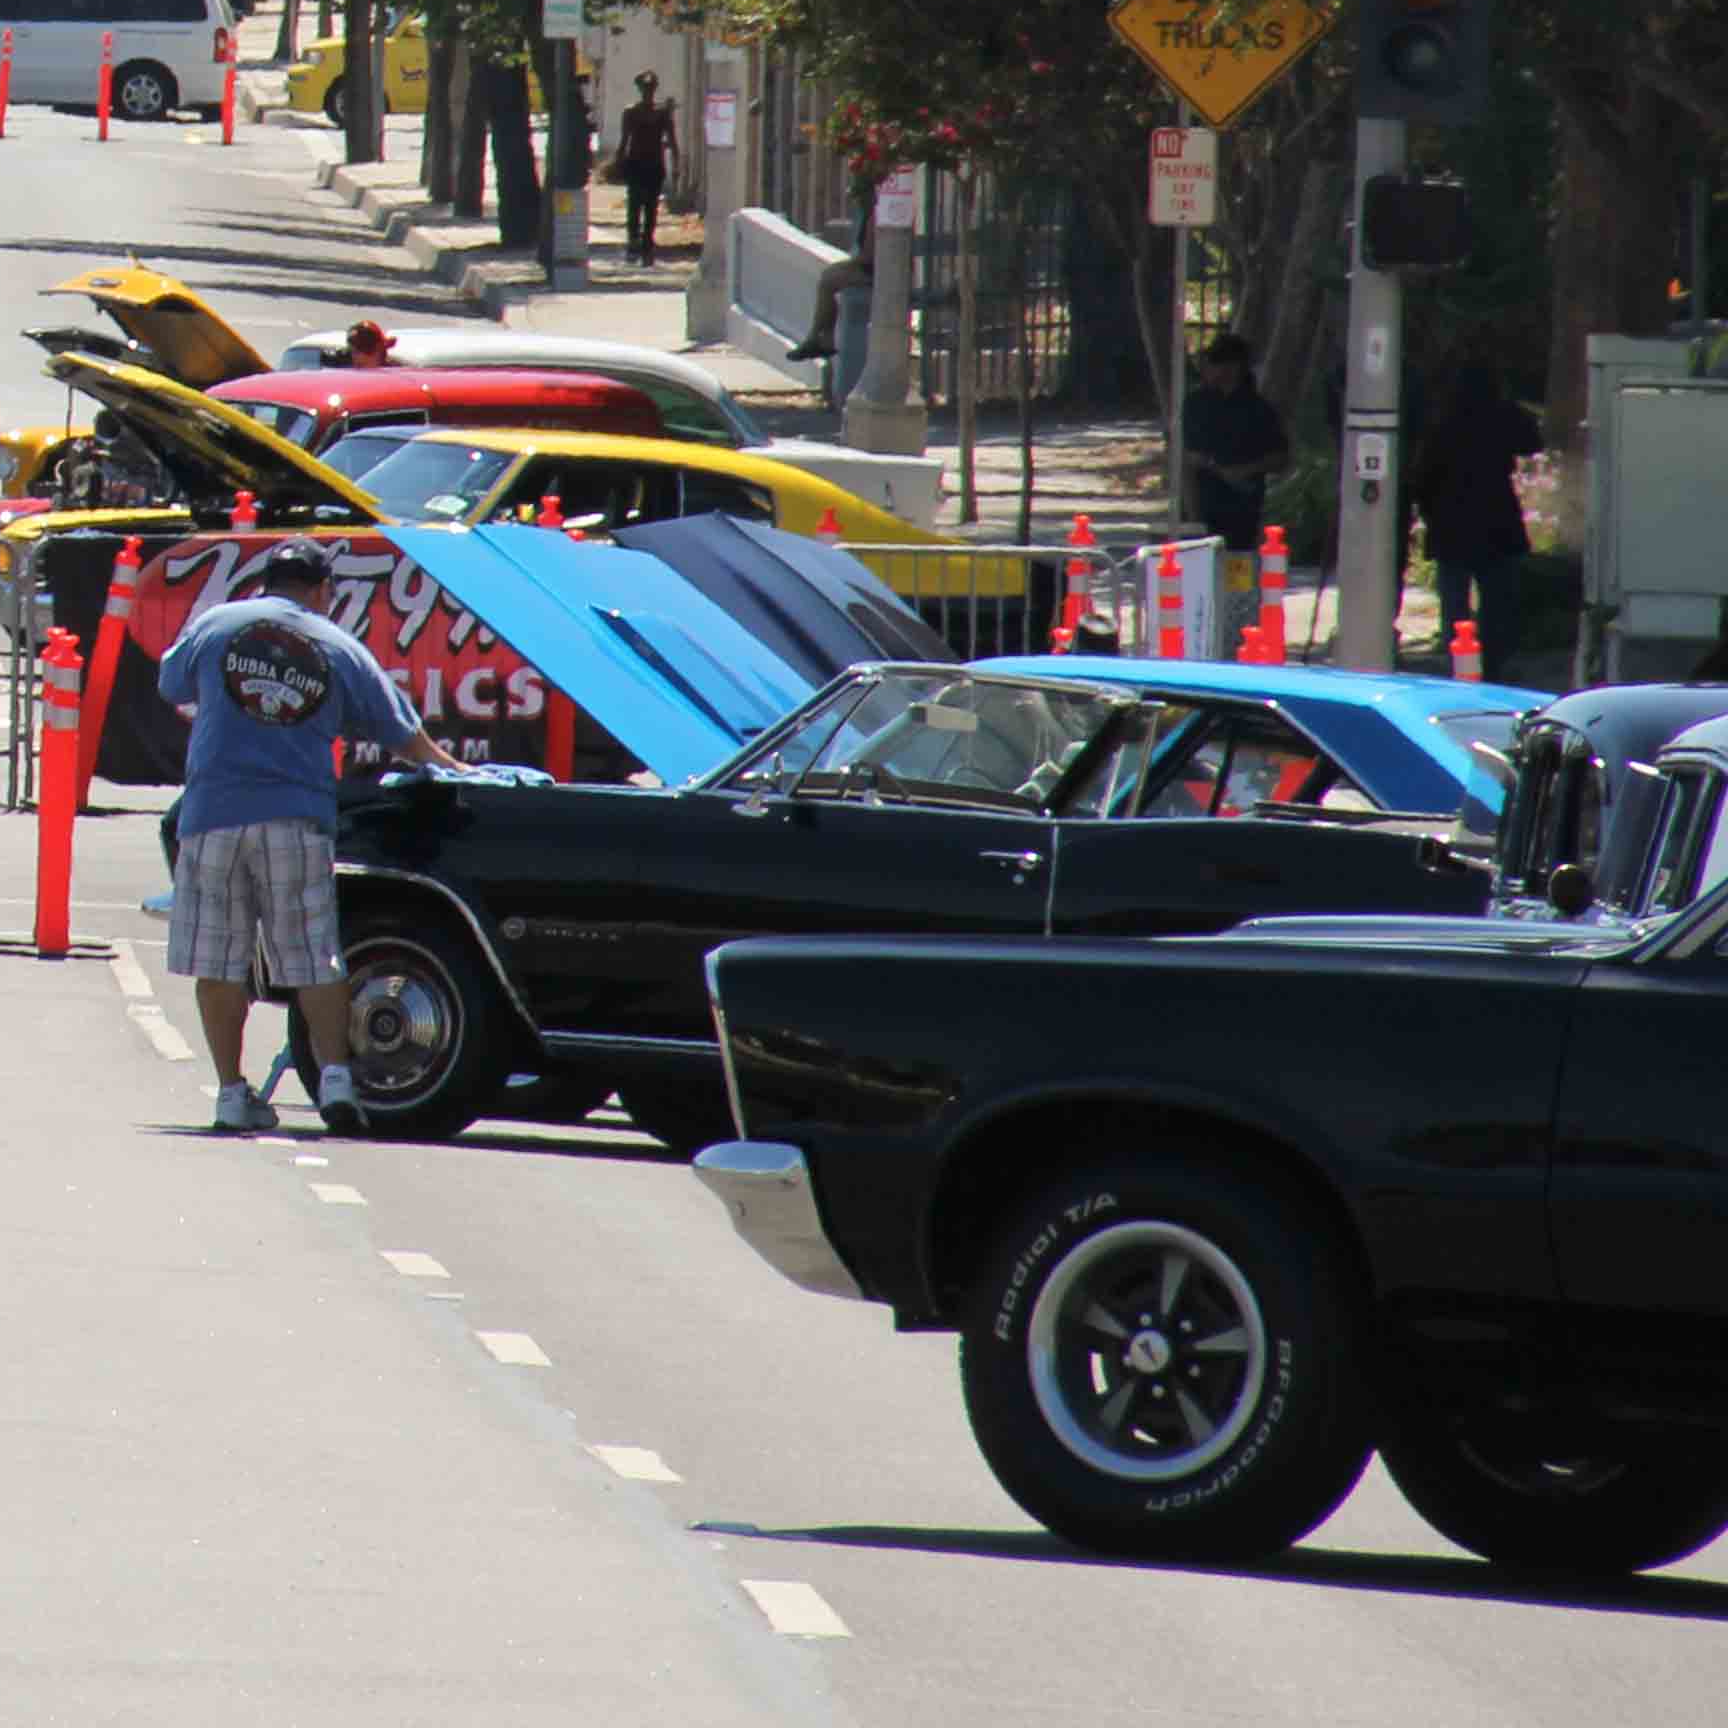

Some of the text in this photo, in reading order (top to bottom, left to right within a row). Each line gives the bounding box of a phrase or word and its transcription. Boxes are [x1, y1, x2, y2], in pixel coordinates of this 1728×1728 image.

[1156, 133, 1181, 154] NO
[226, 653, 277, 680] BUBBA
[284, 666, 326, 697] GUMP
